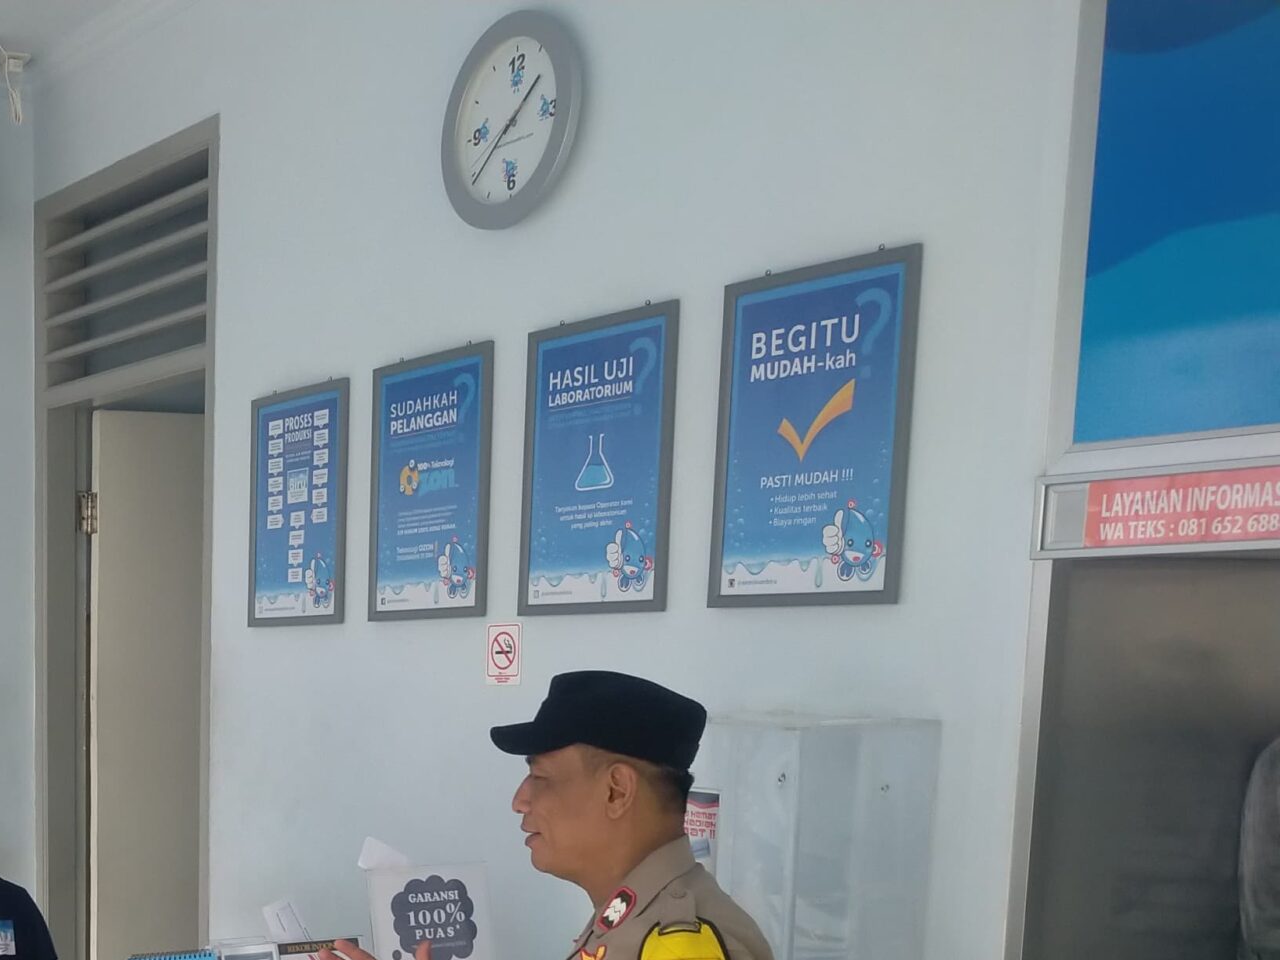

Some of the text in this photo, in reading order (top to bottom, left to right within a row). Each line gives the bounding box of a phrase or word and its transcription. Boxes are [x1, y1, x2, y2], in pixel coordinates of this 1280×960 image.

[509, 54, 525, 73] 12
[473, 128, 481, 146] 9
[507, 174, 516, 190] 6
[751, 314, 860, 360] BEGITU
[549, 356, 633, 391] HASIL UJI
[750, 349, 856, 383] MUDAH-kah
[390, 390, 458, 417] SUDAHKAH
[548, 380, 633, 408] LABORATORIUM
[284, 412, 312, 432] PROSES
[390, 408, 457, 435] PELANGGAN
[284, 428, 312, 444] PRODUKSI
[760, 468, 853, 488] PASTI MUDAH !!!
[1101, 488, 1183, 517] LAYANAN
[1100, 522, 1124, 540] WA
[1128, 519, 1166, 539] TEKS
[1178, 518, 1207, 536] 081
[1211, 515, 1243, 535] 652
[1247, 513, 1280, 532] 688
[408, 889, 459, 904] GARANSI
[407, 901, 466, 926] 100%
